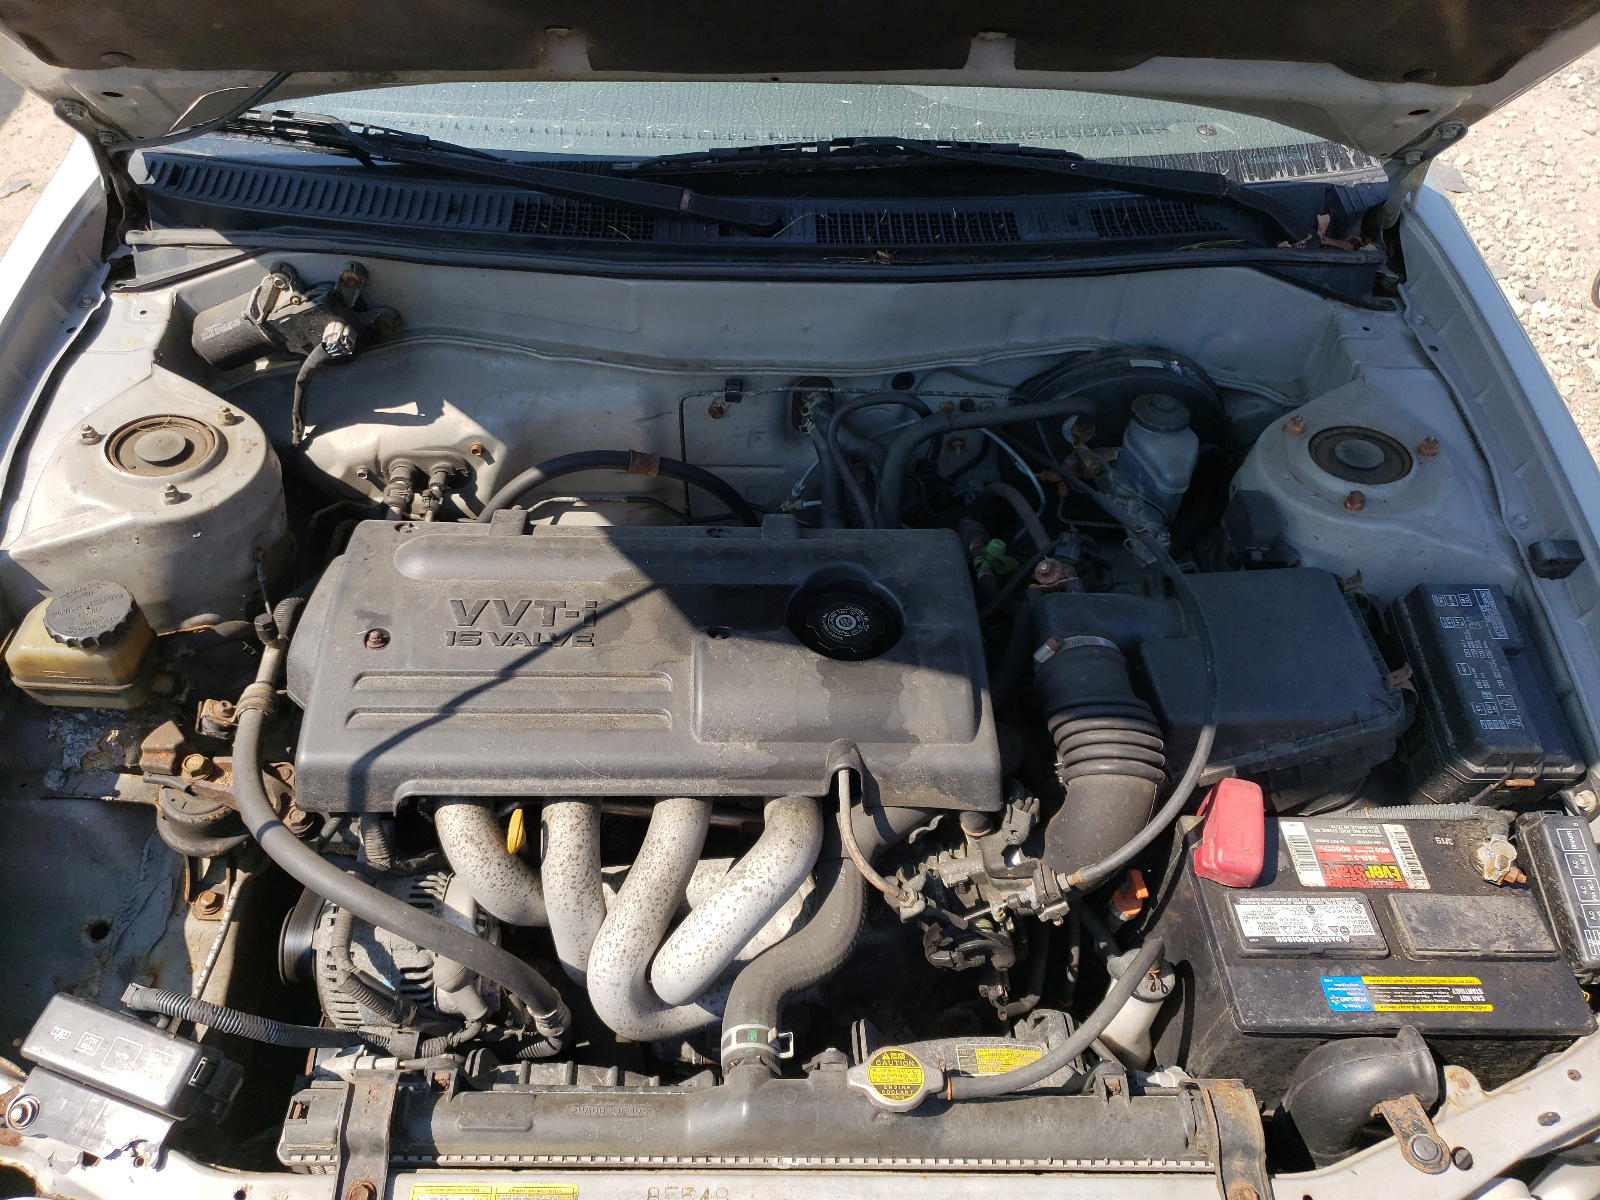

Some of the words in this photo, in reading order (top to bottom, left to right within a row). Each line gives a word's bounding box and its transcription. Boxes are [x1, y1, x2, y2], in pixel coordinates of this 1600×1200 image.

[449, 599, 598, 627] VVT-i
[445, 631, 482, 646] 16
[487, 631, 595, 647] VALVE
